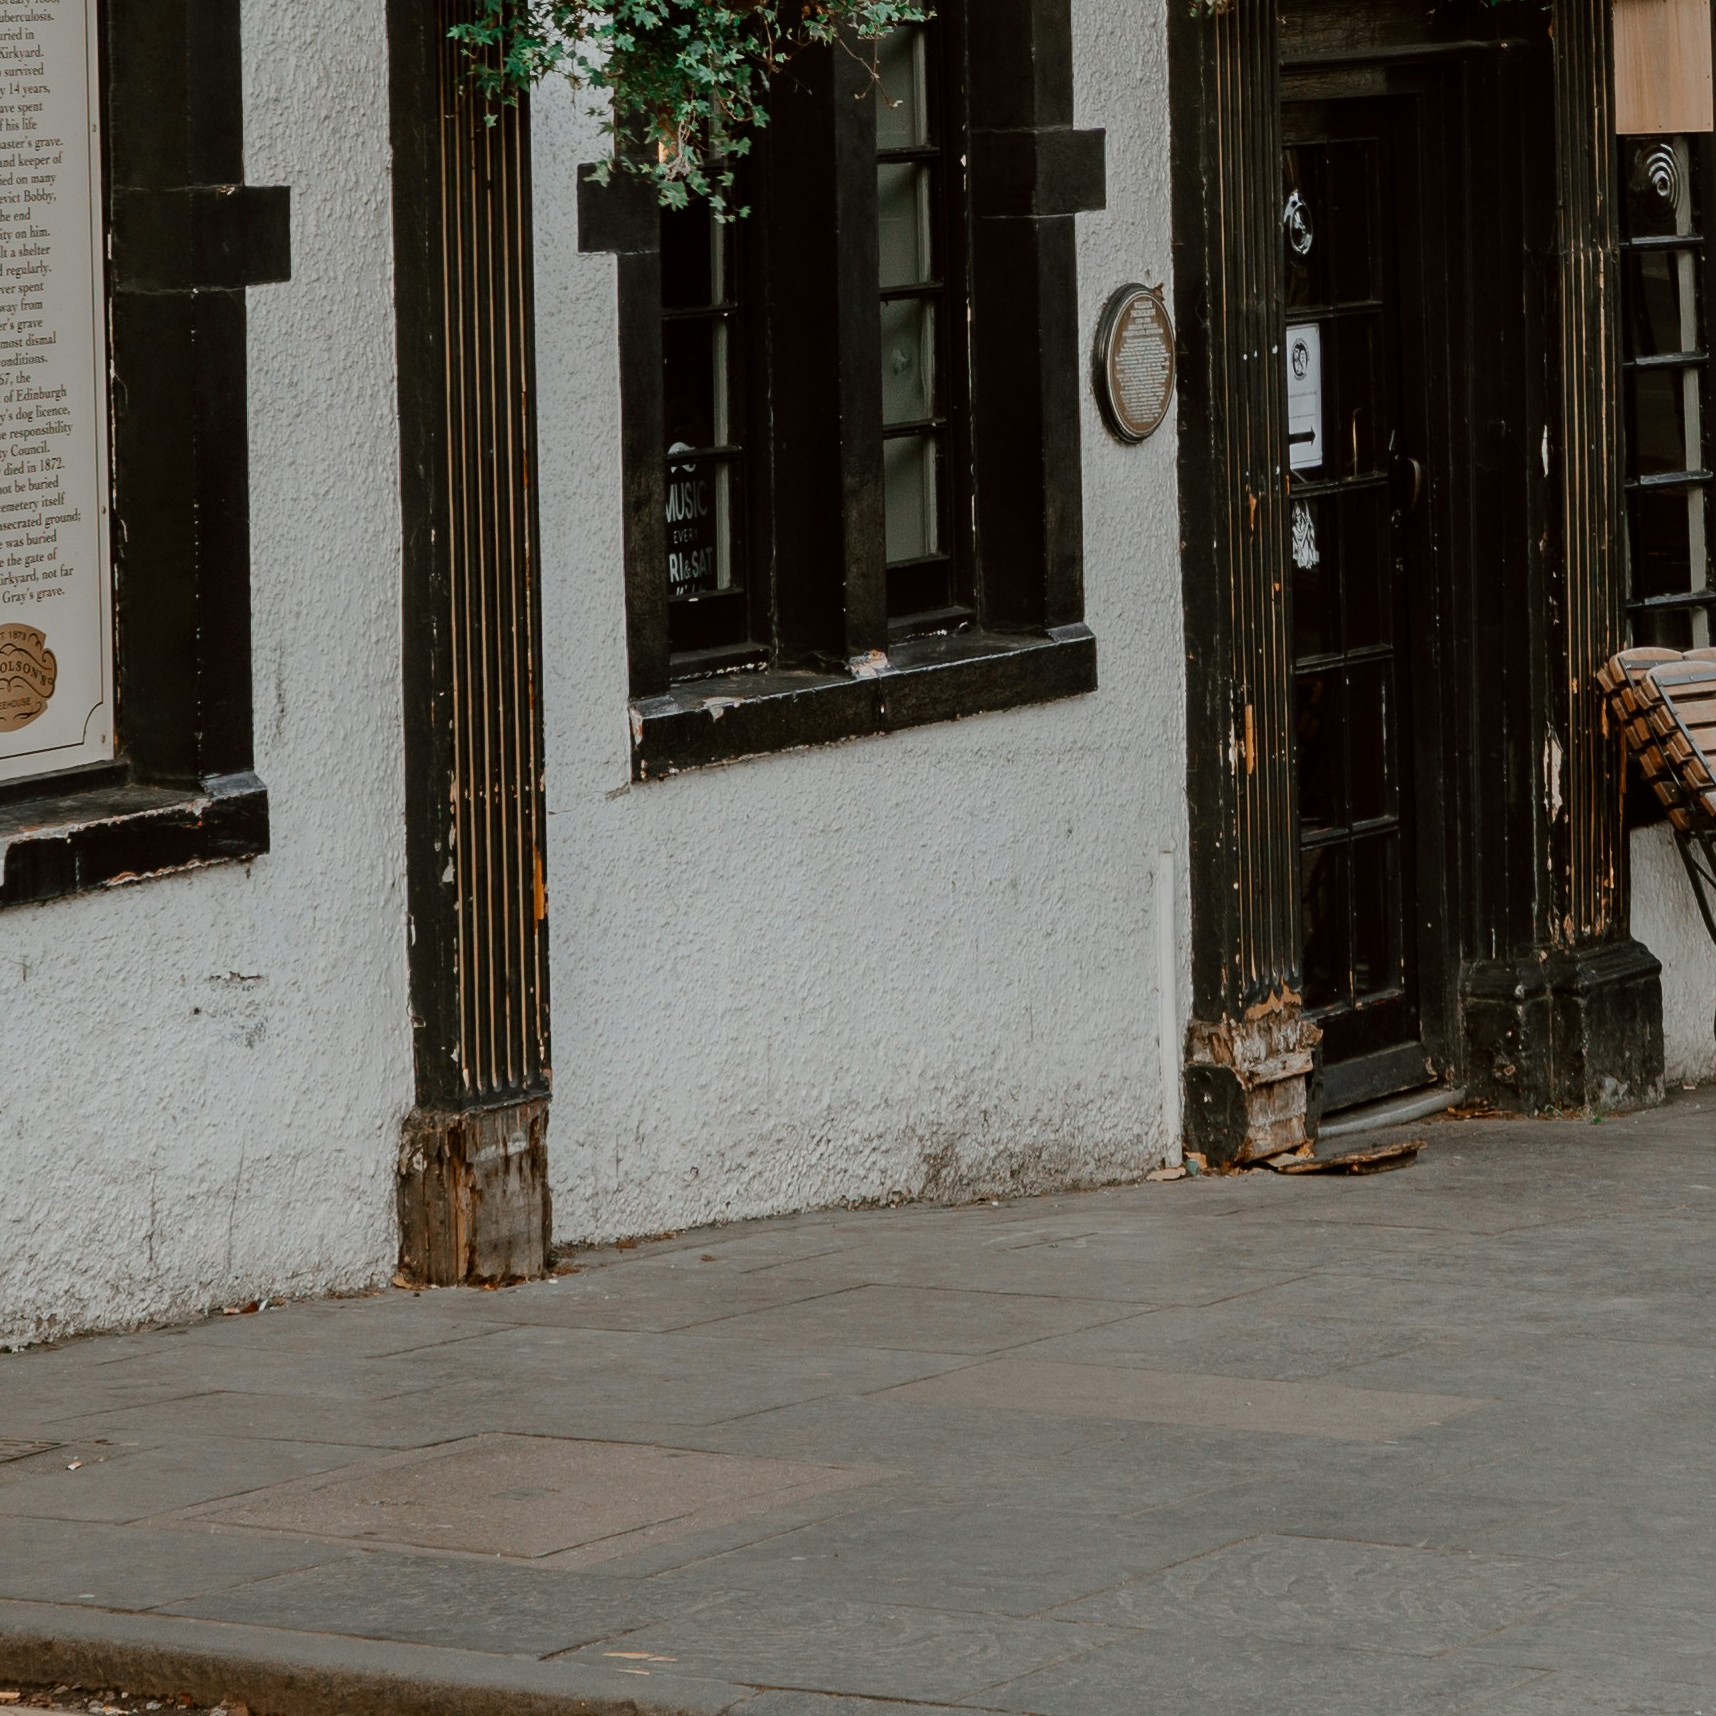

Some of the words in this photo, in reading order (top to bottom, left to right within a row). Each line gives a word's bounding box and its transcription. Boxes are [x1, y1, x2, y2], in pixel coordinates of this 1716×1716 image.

[24, 27, 35, 40] in
[4, 59, 44, 77] survived
[9, 82, 20, 95] 14
[17, 102, 44, 117] spent
[5, 118, 20, 131] his
[22, 116, 37, 130] life
[18, 153, 51, 170] keeper
[52, 150, 63, 164] of
[16, 177, 28, 185] on
[30, 174, 56, 187] many
[13, 206, 31, 221] end
[15, 229, 28, 239] on
[10, 249, 16, 258] a
[18, 242, 51, 257] shelter
[18, 282, 44, 297] spent
[20, 297, 43, 311] from
[16, 319, 43, 334] grave
[0, 338, 23, 349] most
[25, 330, 57, 347] dismal
[16, 370, 31, 384] the
[3, 389, 15, 403] of
[16, 384, 67, 402] Edinburgh
[15, 406, 34, 423] dog
[9, 420, 74, 442] responsibility
[3, 460, 25, 476] died
[27, 460, 37, 473] in
[14, 479, 26, 493] be
[28, 474, 59, 491] buried
[41, 491, 66, 508] itself
[5, 539, 24, 548] was
[25, 528, 57, 546] buried
[7, 552, 22, 567] the
[24, 554, 45, 568] gate
[47, 546, 58, 561] of
[42, 569, 58, 580] not
[60, 563, 74, 577] far
